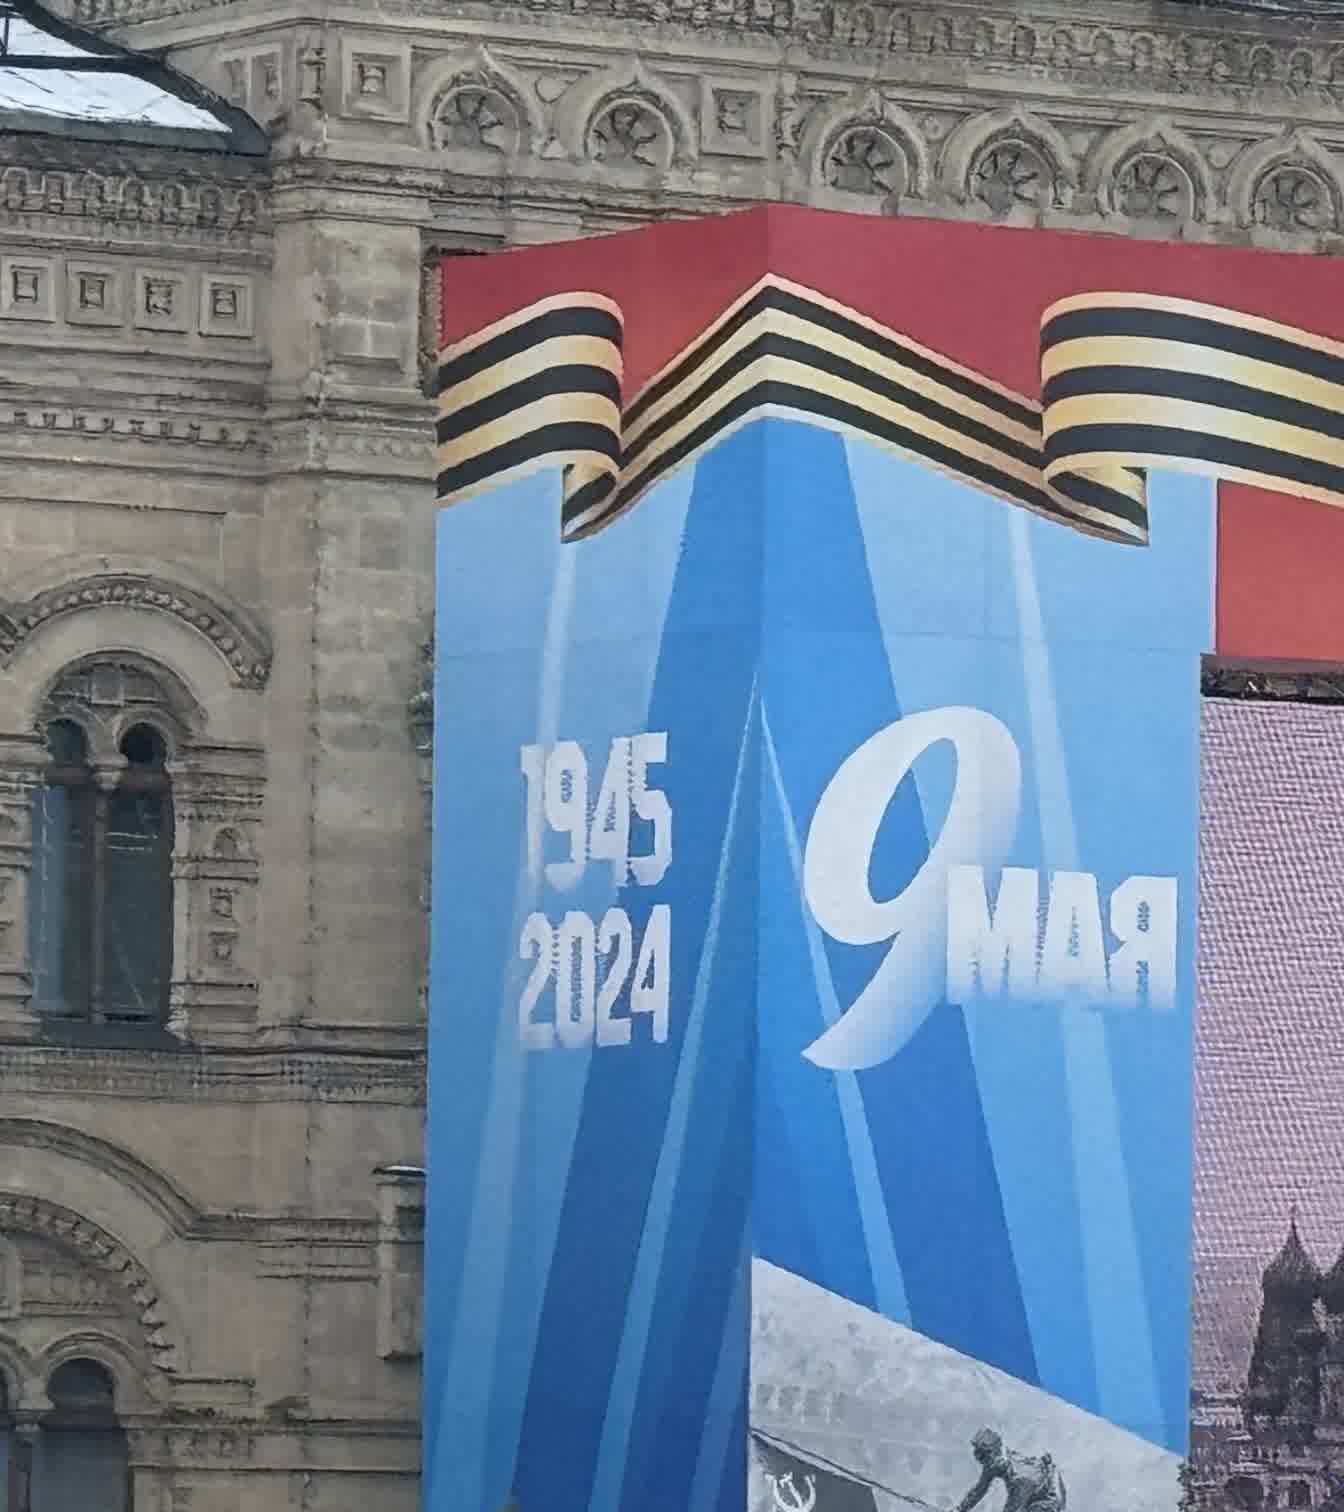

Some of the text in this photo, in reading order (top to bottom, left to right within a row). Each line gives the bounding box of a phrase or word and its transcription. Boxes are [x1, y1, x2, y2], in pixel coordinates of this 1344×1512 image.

[519, 730, 674, 893] 1945
[801, 705, 1179, 1071] 9 МАЯ
[518, 903, 673, 1050] 2024
